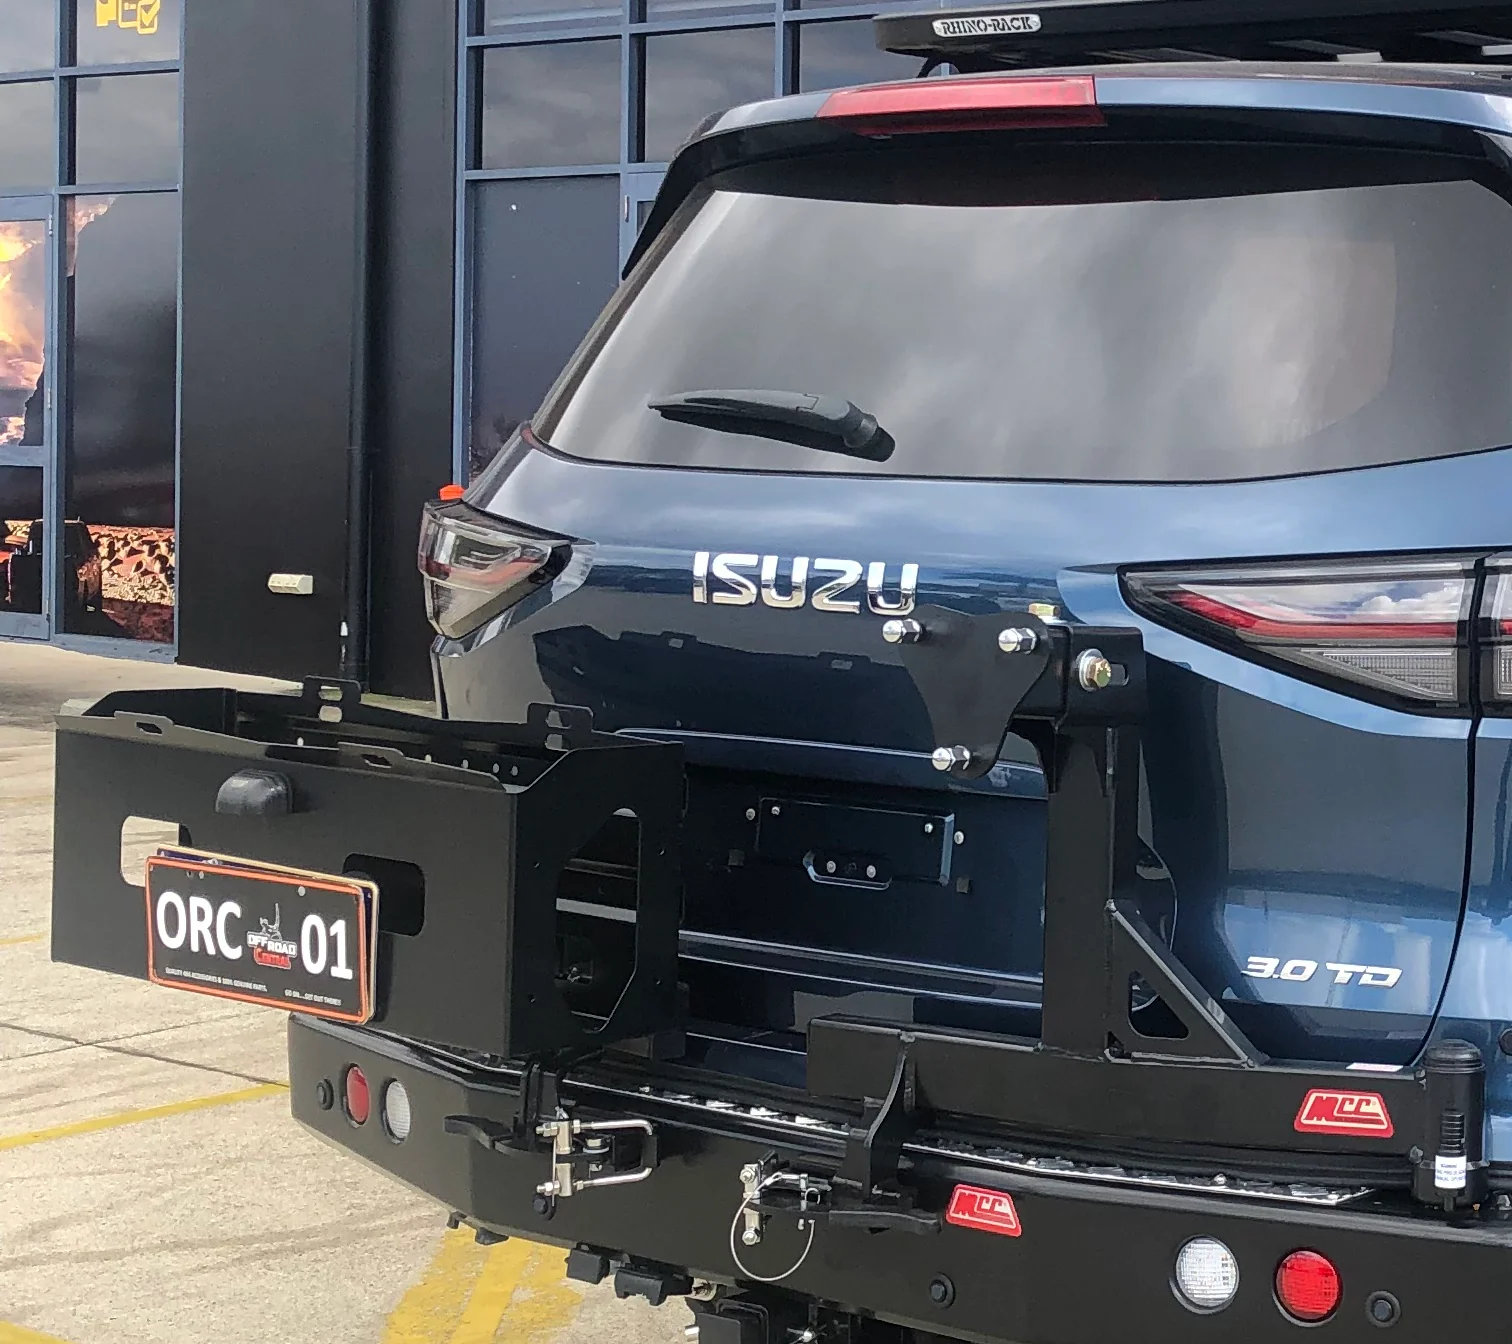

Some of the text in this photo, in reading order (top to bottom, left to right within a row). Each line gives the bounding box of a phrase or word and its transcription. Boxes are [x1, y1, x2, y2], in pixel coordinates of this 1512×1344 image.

[941, 17, 1033, 34] RHINO-RACK
[693, 551, 919, 616] ISUZU
[156, 891, 353, 980] ORC 01
[1241, 956, 1403, 988] 3.0 TD
